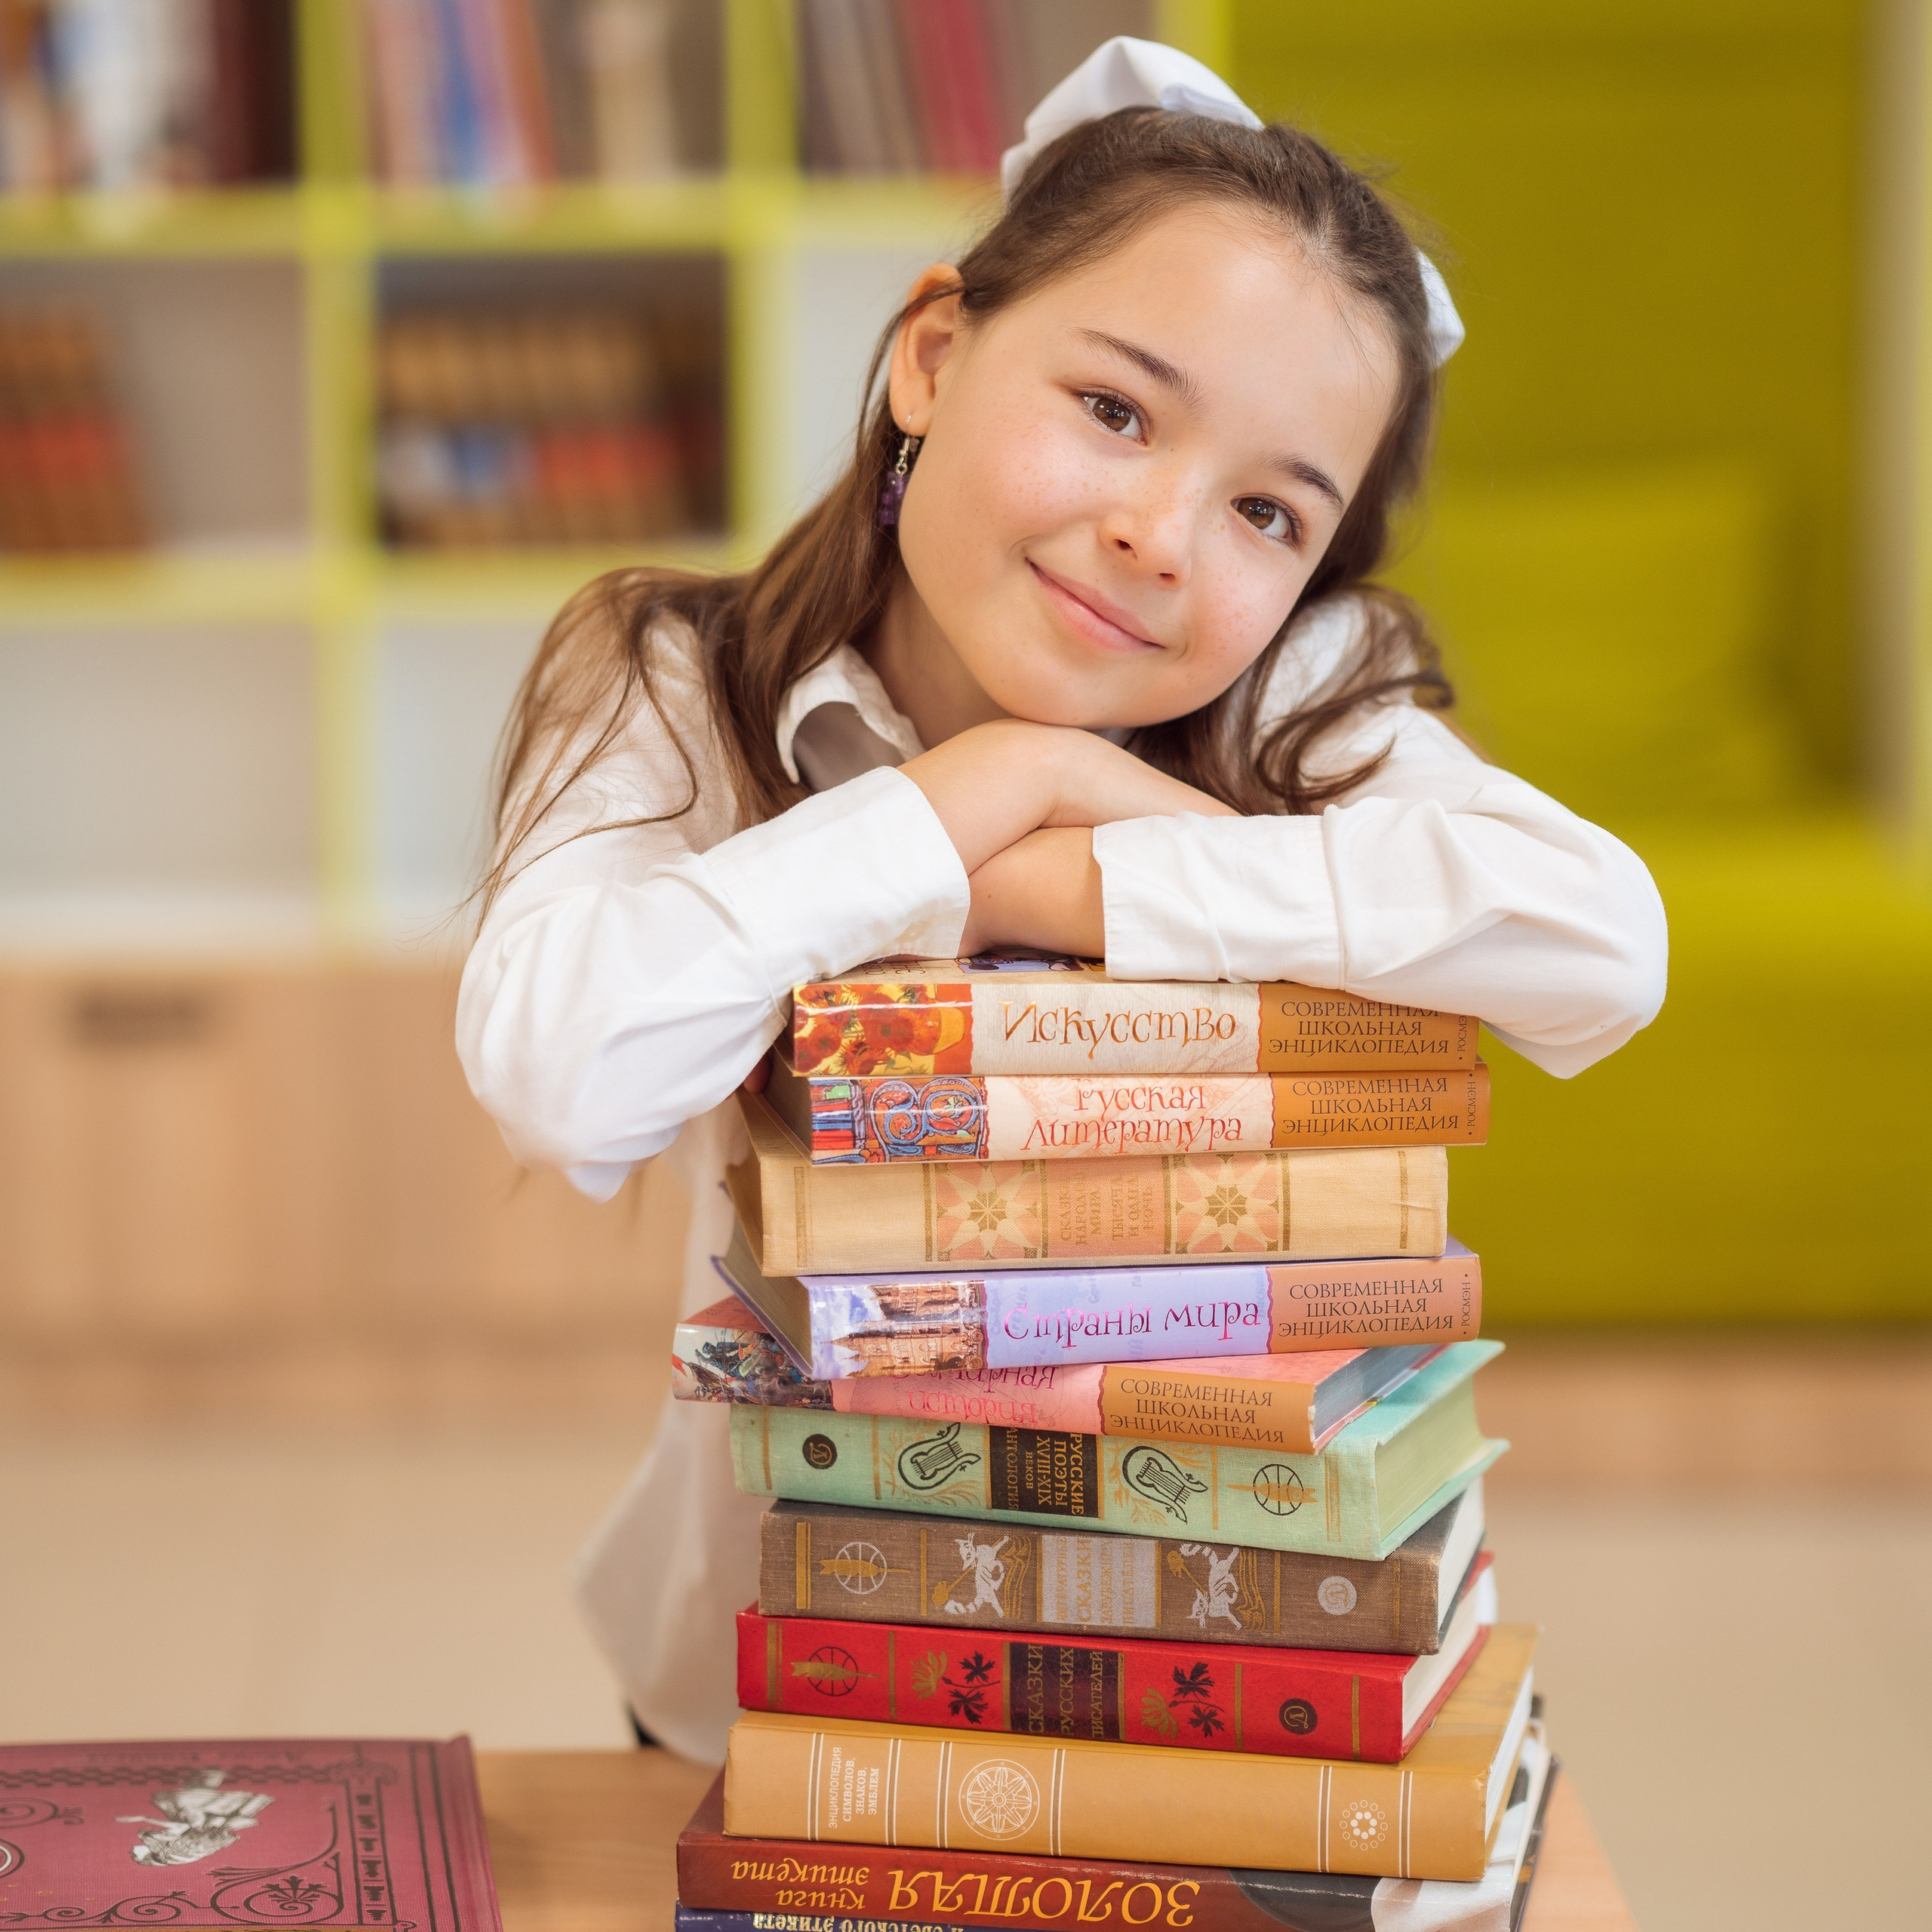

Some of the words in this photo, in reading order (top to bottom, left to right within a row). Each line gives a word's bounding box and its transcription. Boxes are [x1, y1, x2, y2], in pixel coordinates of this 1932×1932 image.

[998, 1001, 1236, 1060] Искусство
[1269, 1038, 1449, 1057] ЭНЦИКЛОПЕДИЯ
[1298, 1021, 1423, 1036] ШКОЛЬНАЯ
[1457, 1015, 1468, 1052] РОСМЭ
[1071, 1078, 1206, 1122] Русская
[1293, 1077, 1448, 1096] СОВРЕМЕННАЯ
[1310, 1097, 1432, 1115] ШКОЛЬНАЯ
[1466, 1081, 1477, 1128] РОСМЭН
[1020, 1115, 1244, 1154] Литература
[1282, 1115, 1459, 1137] ЭНЦИКЛОПЕДИЯ
[1289, 1278, 1444, 1300] СОВРЕМЕННАЯ
[1306, 1298, 1428, 1318] ШКОЛЬНАЯ
[1461, 1281, 1471, 1327] РОСМЭН
[1004, 1302, 1152, 1349] Страны
[1164, 1301, 1261, 1341] мира
[1278, 1315, 1454, 1339] ЭНЦИКЛОПЕДИЯ
[907, 1391, 1038, 1424] история
[1121, 1378, 1273, 1407] СОВРЕМЕННАЯ
[1136, 1399, 1256, 1424] ШКОЛЬНАЯ
[1110, 1414, 1285, 1443] ЭНЦИКЛОПЕДИЯ
[1007, 1426, 1019, 1510] АНТОЛОГИЯ
[1025, 1451, 1034, 1490] ВЕКОВ
[1054, 1440, 1068, 1506] ПОЭТЫ
[1070, 1433, 1084, 1515] РУССКИЕ
[1076, 1539, 1092, 1623] СКАЗКИ
[1027, 1644, 1044, 1734] СКАЗКИ
[1060, 1647, 1075, 1736] РУССКИХ
[1090, 1651, 1104, 1739] ПИСАТЕЛЕЙ
[829, 1746, 841, 1829] ЭНЦИКЛОПЕДИЯ
[842, 1758, 856, 1822] СИМВОЛОВ,
[856, 1767, 868, 1815] ЗНАКОВ,
[868, 1767, 879, 1815] ЭМБЛЕМ
[731, 1857, 870, 1886] этикета
[775, 1887, 866, 1910] книга
[888, 1869, 1201, 1927] ЗОЛОТАЯ
